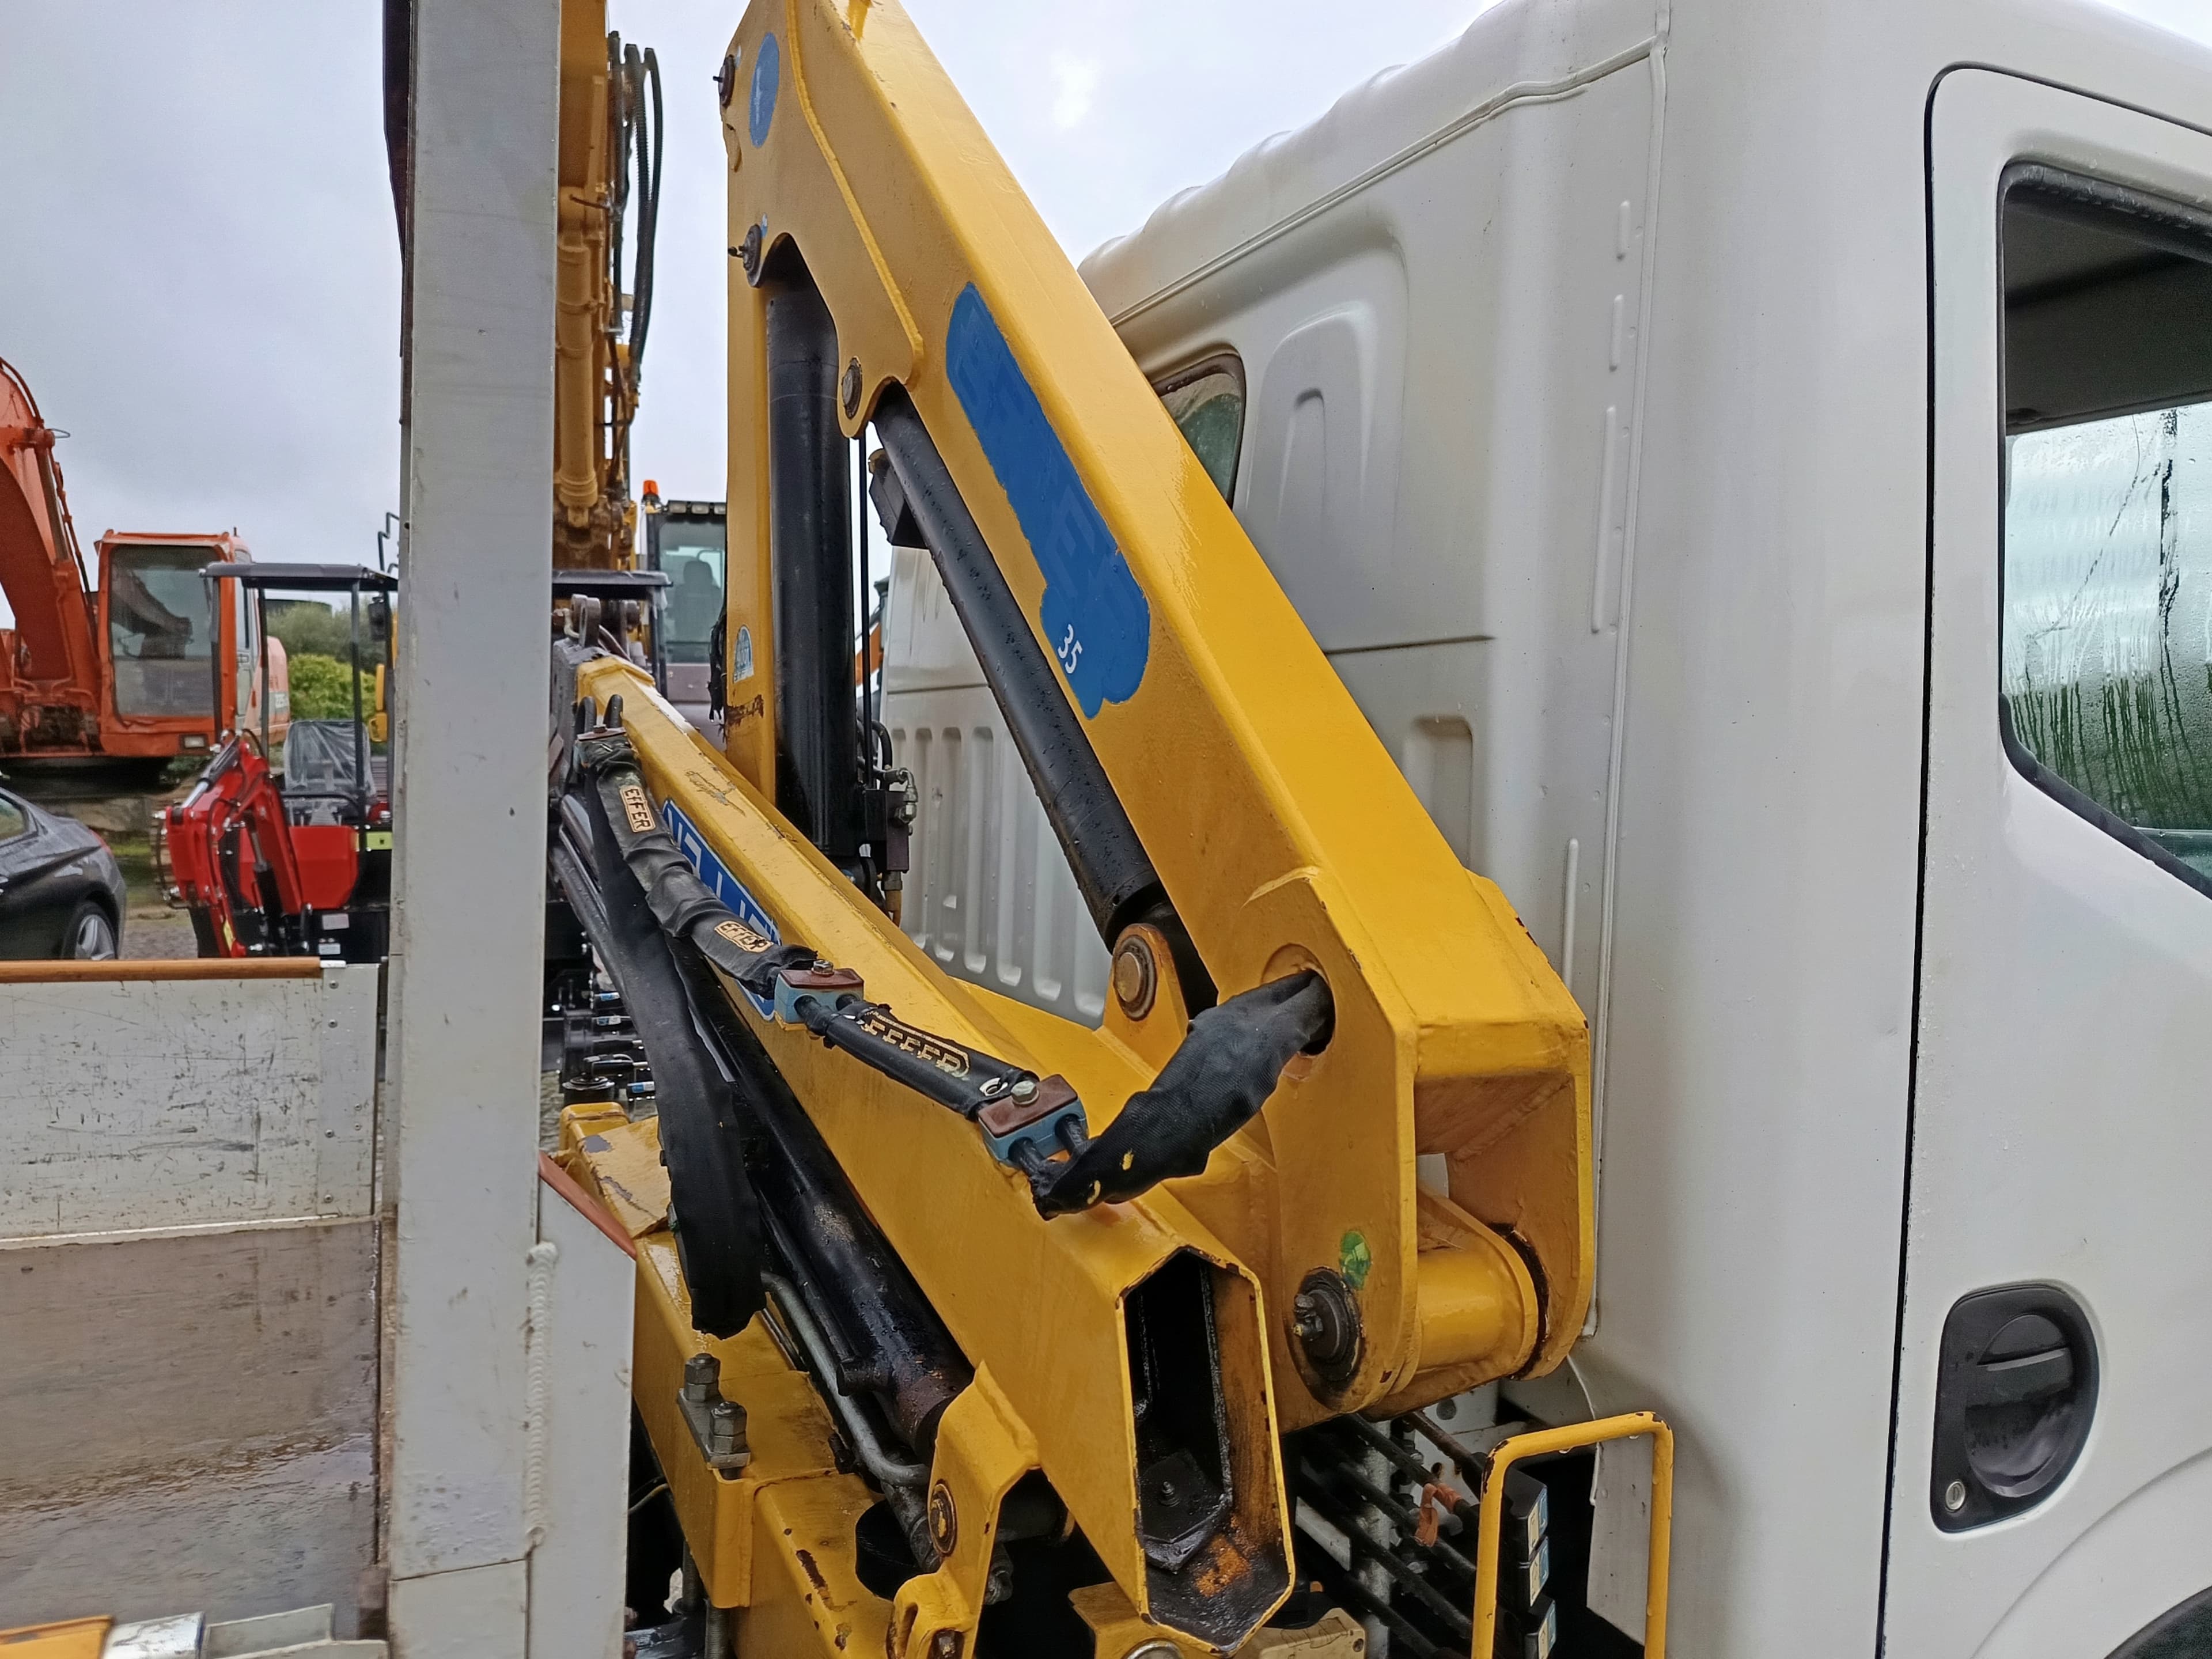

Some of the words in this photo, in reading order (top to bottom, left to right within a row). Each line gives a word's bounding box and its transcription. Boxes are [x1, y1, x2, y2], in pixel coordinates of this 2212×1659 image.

[1058, 624, 1083, 674] 35
[624, 788, 652, 829] EFFER
[720, 923, 768, 950] EFFER
